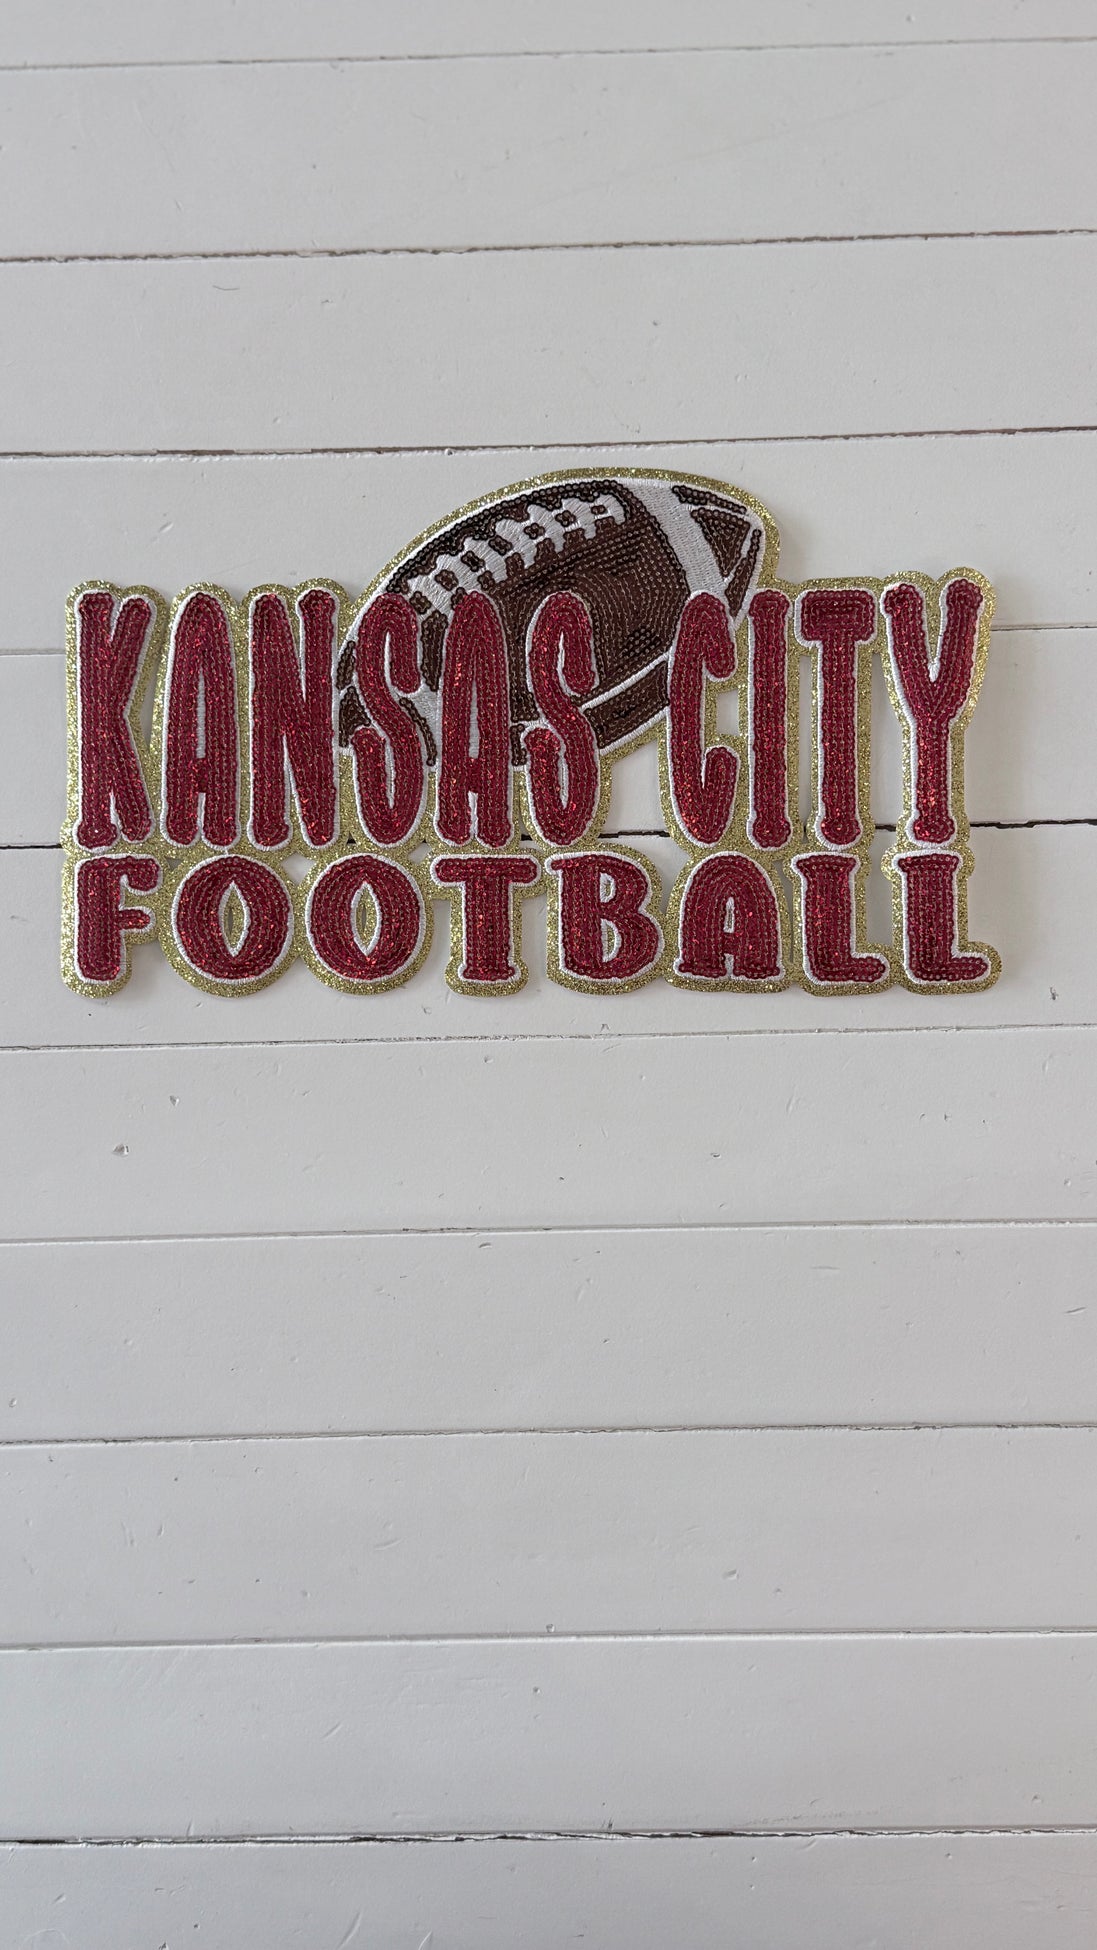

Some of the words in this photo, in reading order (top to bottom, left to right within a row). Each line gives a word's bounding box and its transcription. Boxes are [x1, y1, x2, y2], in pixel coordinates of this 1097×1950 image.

[75, 588, 601, 850] KANSAS
[667, 577, 985, 850] CITY
[75, 852, 990, 984] FOOTBALL
